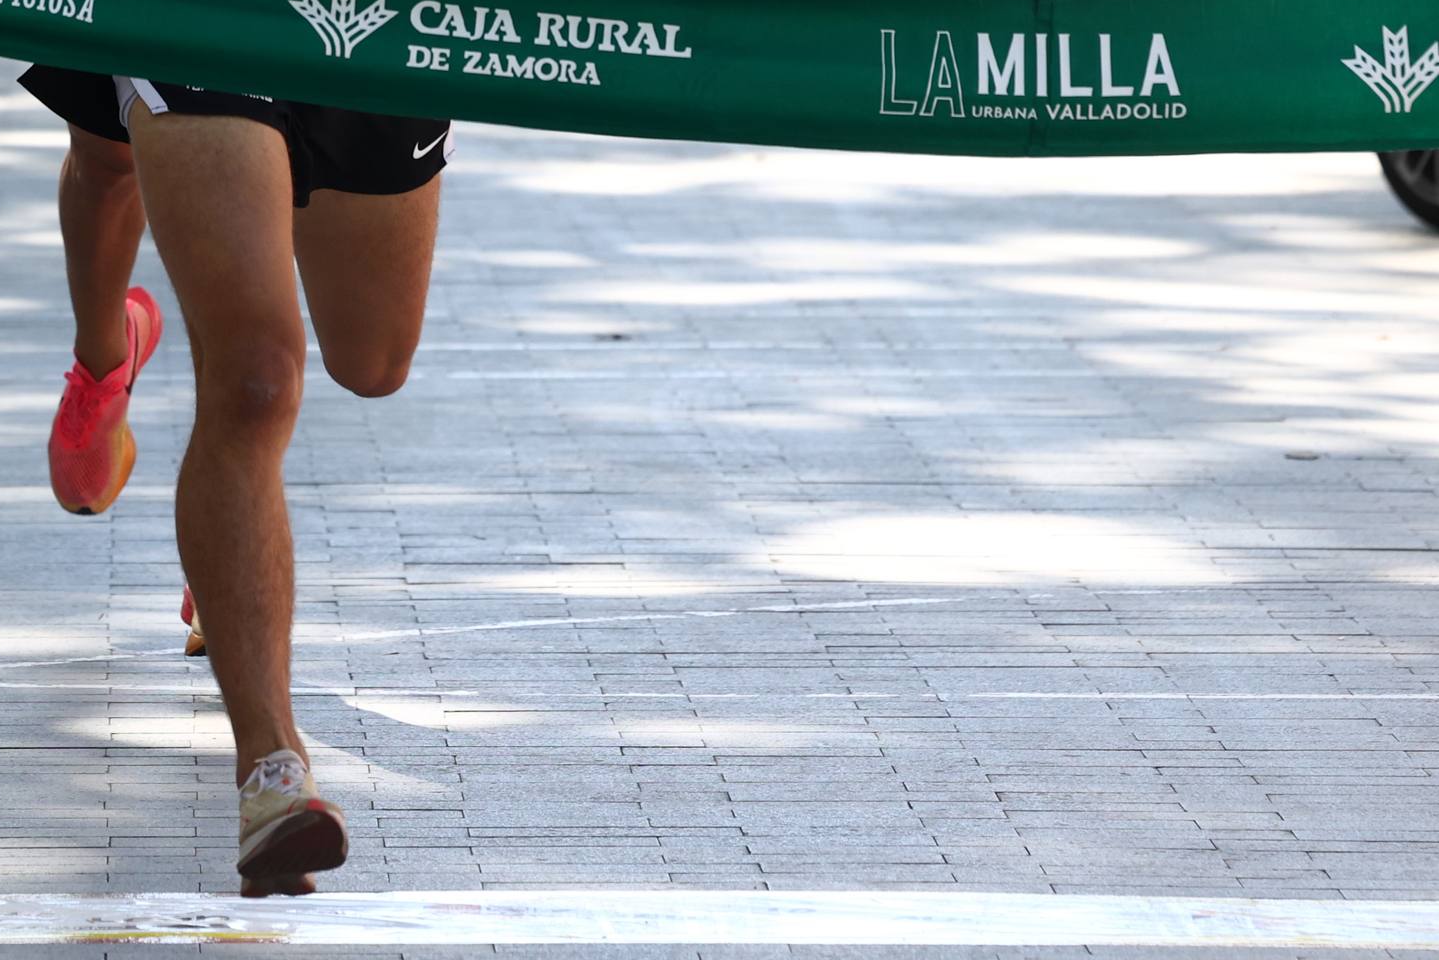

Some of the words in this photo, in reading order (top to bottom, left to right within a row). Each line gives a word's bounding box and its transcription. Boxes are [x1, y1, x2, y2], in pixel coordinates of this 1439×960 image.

[410, 0, 521, 44] CAJA
[534, 11, 692, 59] RURAL
[406, 45, 450, 71] DE
[463, 50, 601, 86] ZAMORA
[880, 28, 965, 117] LA
[976, 31, 1181, 97] MILLA
[971, 105, 1038, 120] URBANA
[1045, 102, 1187, 121] VALLADOLID
